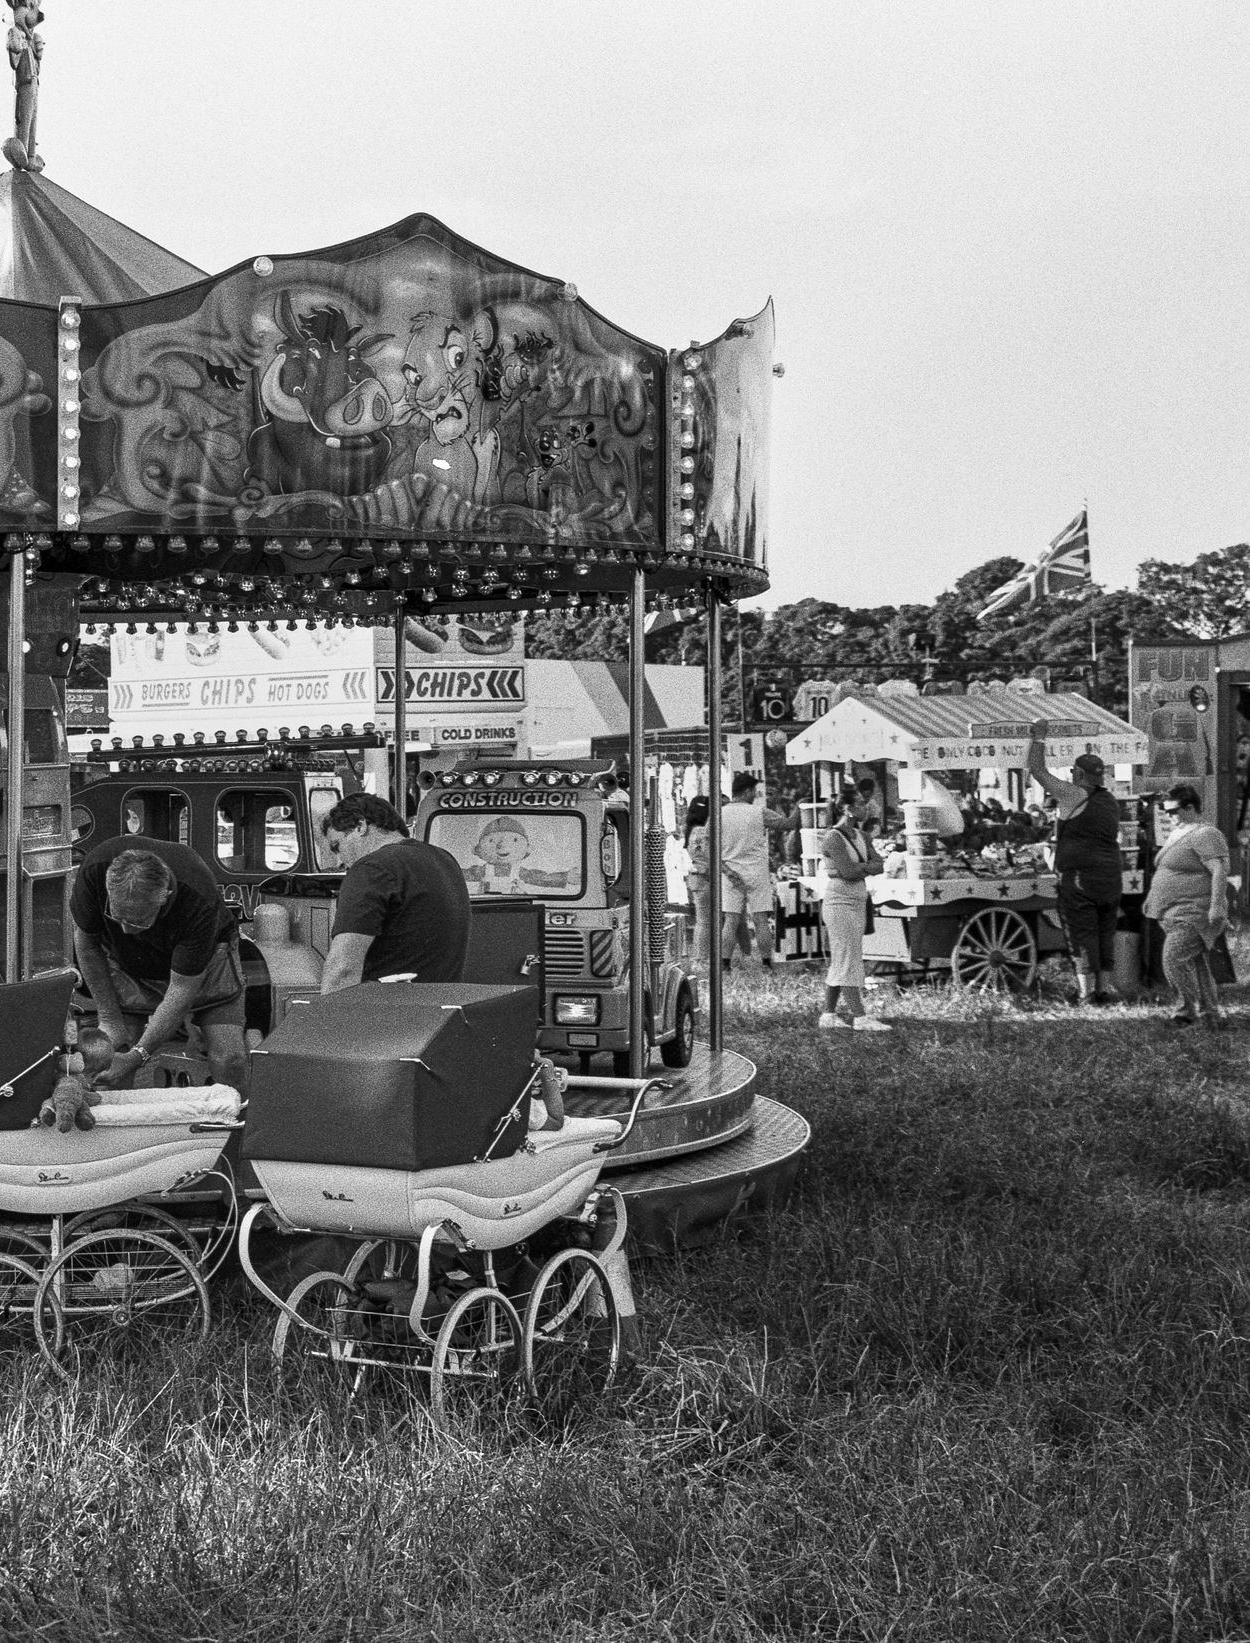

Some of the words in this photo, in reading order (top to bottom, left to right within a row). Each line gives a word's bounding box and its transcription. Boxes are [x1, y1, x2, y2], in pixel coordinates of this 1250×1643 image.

[1138, 649, 1210, 682] FUN
[141, 681, 192, 701] BURGERS
[200, 677, 257, 706] CHIPS
[268, 683, 293, 702] HOT
[296, 681, 329, 700] DOGS
[416, 671, 486, 698] CHIPS
[441, 728, 472, 741] COLD
[474, 727, 516, 740] DRINKS
[439, 791, 578, 809] CONSTRUCTION
